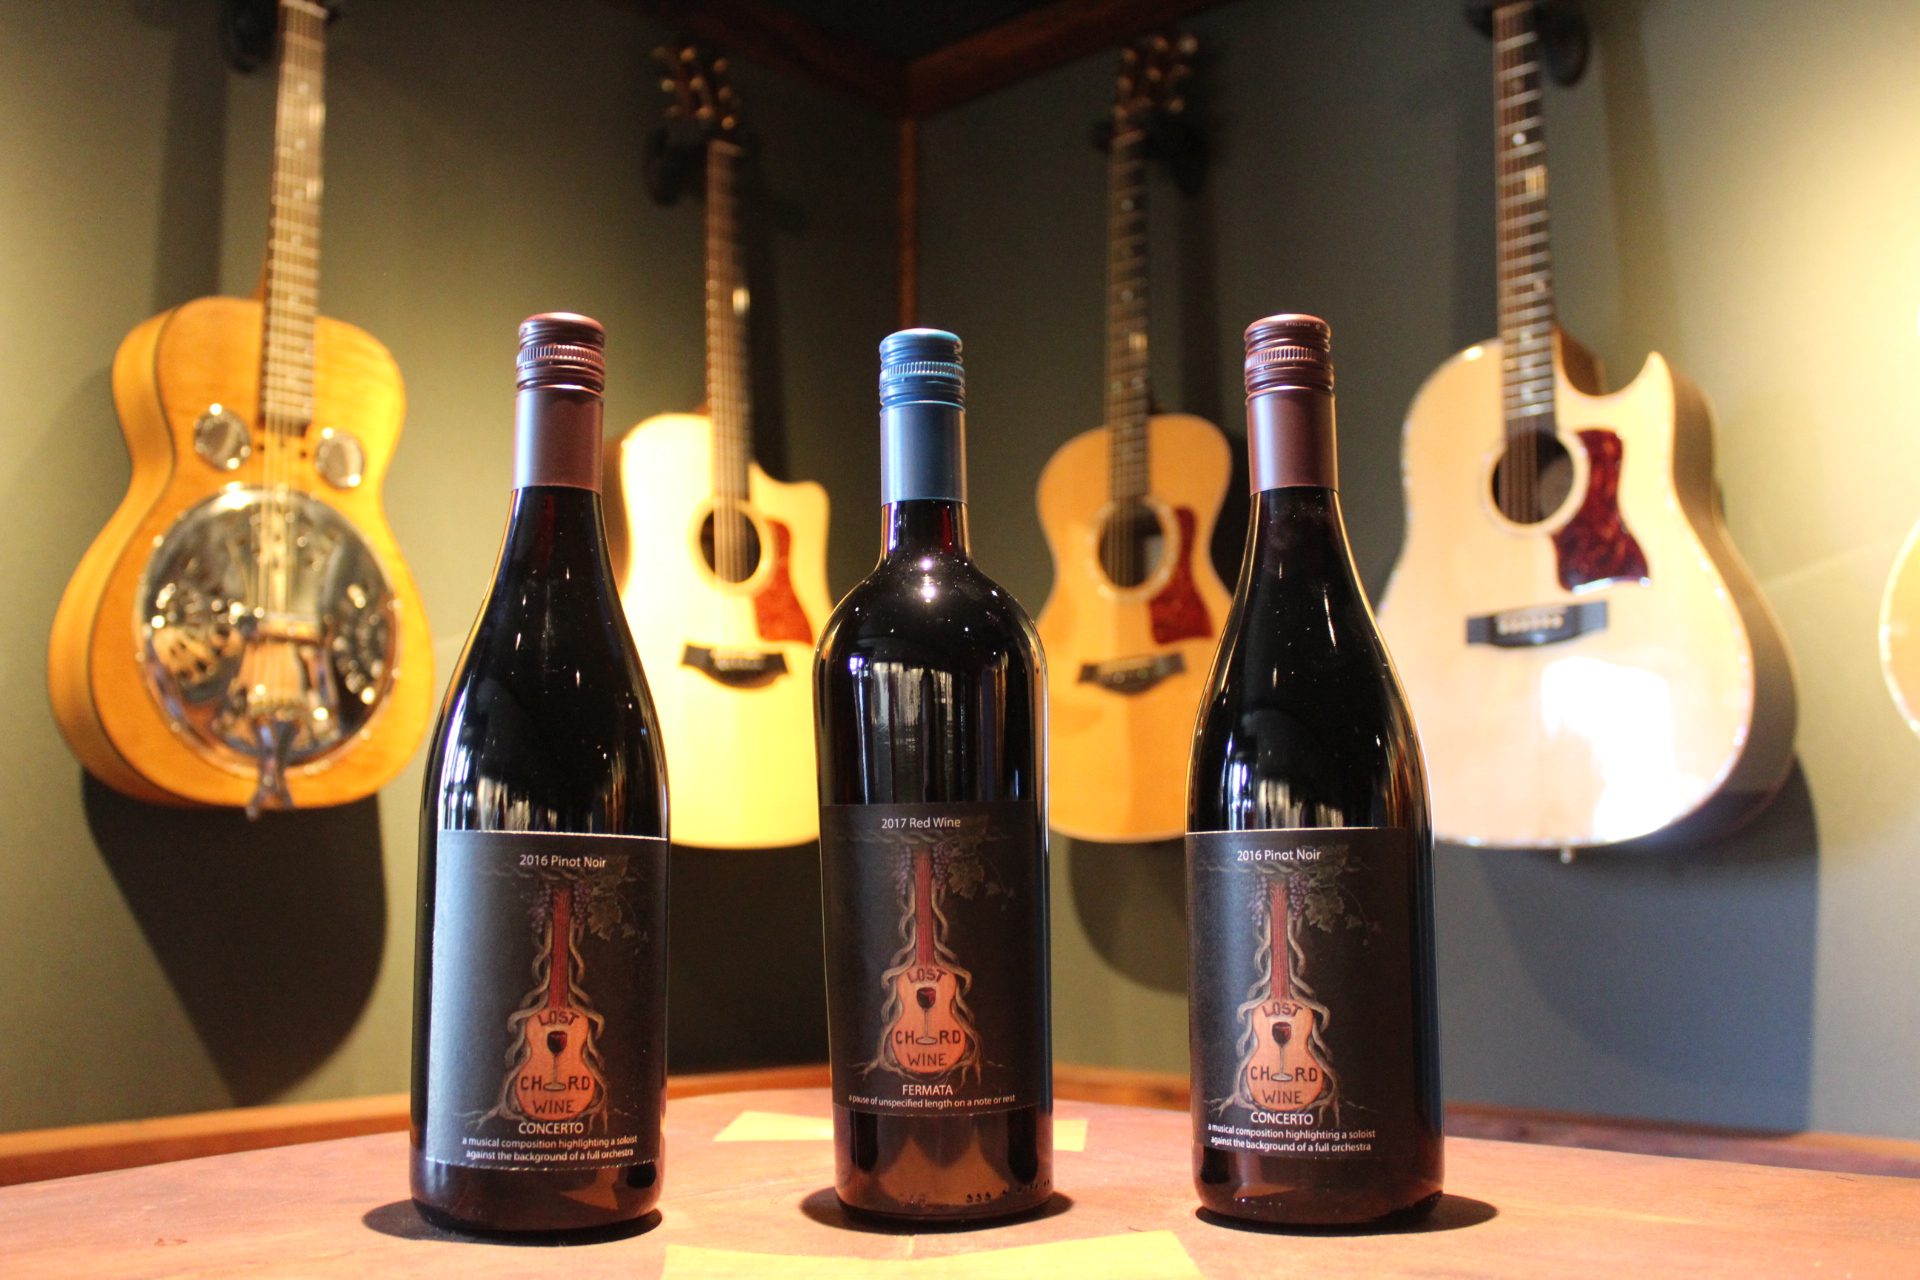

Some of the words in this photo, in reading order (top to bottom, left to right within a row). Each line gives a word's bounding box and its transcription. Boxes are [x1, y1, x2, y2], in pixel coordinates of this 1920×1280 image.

[881, 818, 906, 829] 2017
[909, 817, 931, 828] Red
[932, 817, 961, 828] Wine
[519, 854, 548, 866] 2016
[551, 855, 581, 867] Pinot
[583, 856, 607, 868] Noir
[1237, 850, 1262, 862] 2016
[1264, 849, 1294, 861] Pinot
[1296, 849, 1322, 860] Noir
[907, 968, 947, 983] LOST
[1262, 1002, 1303, 1018] LOST
[537, 1010, 580, 1026] LOST
[907, 1053, 947, 1066] WINE
[902, 1084, 953, 1096] FERMATA
[1262, 1090, 1303, 1104] WINE
[533, 1100, 574, 1114] WINE
[853, 1095, 869, 1104] pause
[870, 1096, 878, 1104] of
[879, 1098, 923, 1109] unspecified
[925, 1099, 952, 1110] length
[974, 1098, 991, 1106] note
[1002, 1094, 1016, 1103] rest
[1250, 1111, 1314, 1125] CONCERTO
[518, 1122, 584, 1134] CONCERTO
[1212, 1124, 1235, 1134] musical
[1235, 1128, 1284, 1138] composition
[1286, 1129, 1340, 1141] highlighting
[1342, 1131, 1347, 1139] a
[1349, 1130, 1376, 1139] soloist
[462, 1137, 467, 1145] a
[468, 1138, 499, 1147] musical
[501, 1139, 556, 1149] composition
[558, 1138, 609, 1150] highlighting
[616, 1135, 637, 1145] soloist
[1211, 1136, 1232, 1146] against
[1233, 1138, 1245, 1148] the
[1246, 1140, 1295, 1152] background
[1297, 1142, 1306, 1151] of
[1308, 1144, 1313, 1152] a
[1315, 1142, 1329, 1152] full
[1331, 1142, 1371, 1152] orchestra
[466, 1149, 495, 1160] against
[497, 1151, 512, 1160] the
[514, 1151, 567, 1163] background
[569, 1151, 578, 1160] of
[587, 1150, 600, 1160] full
[601, 1148, 634, 1159] orchestra
